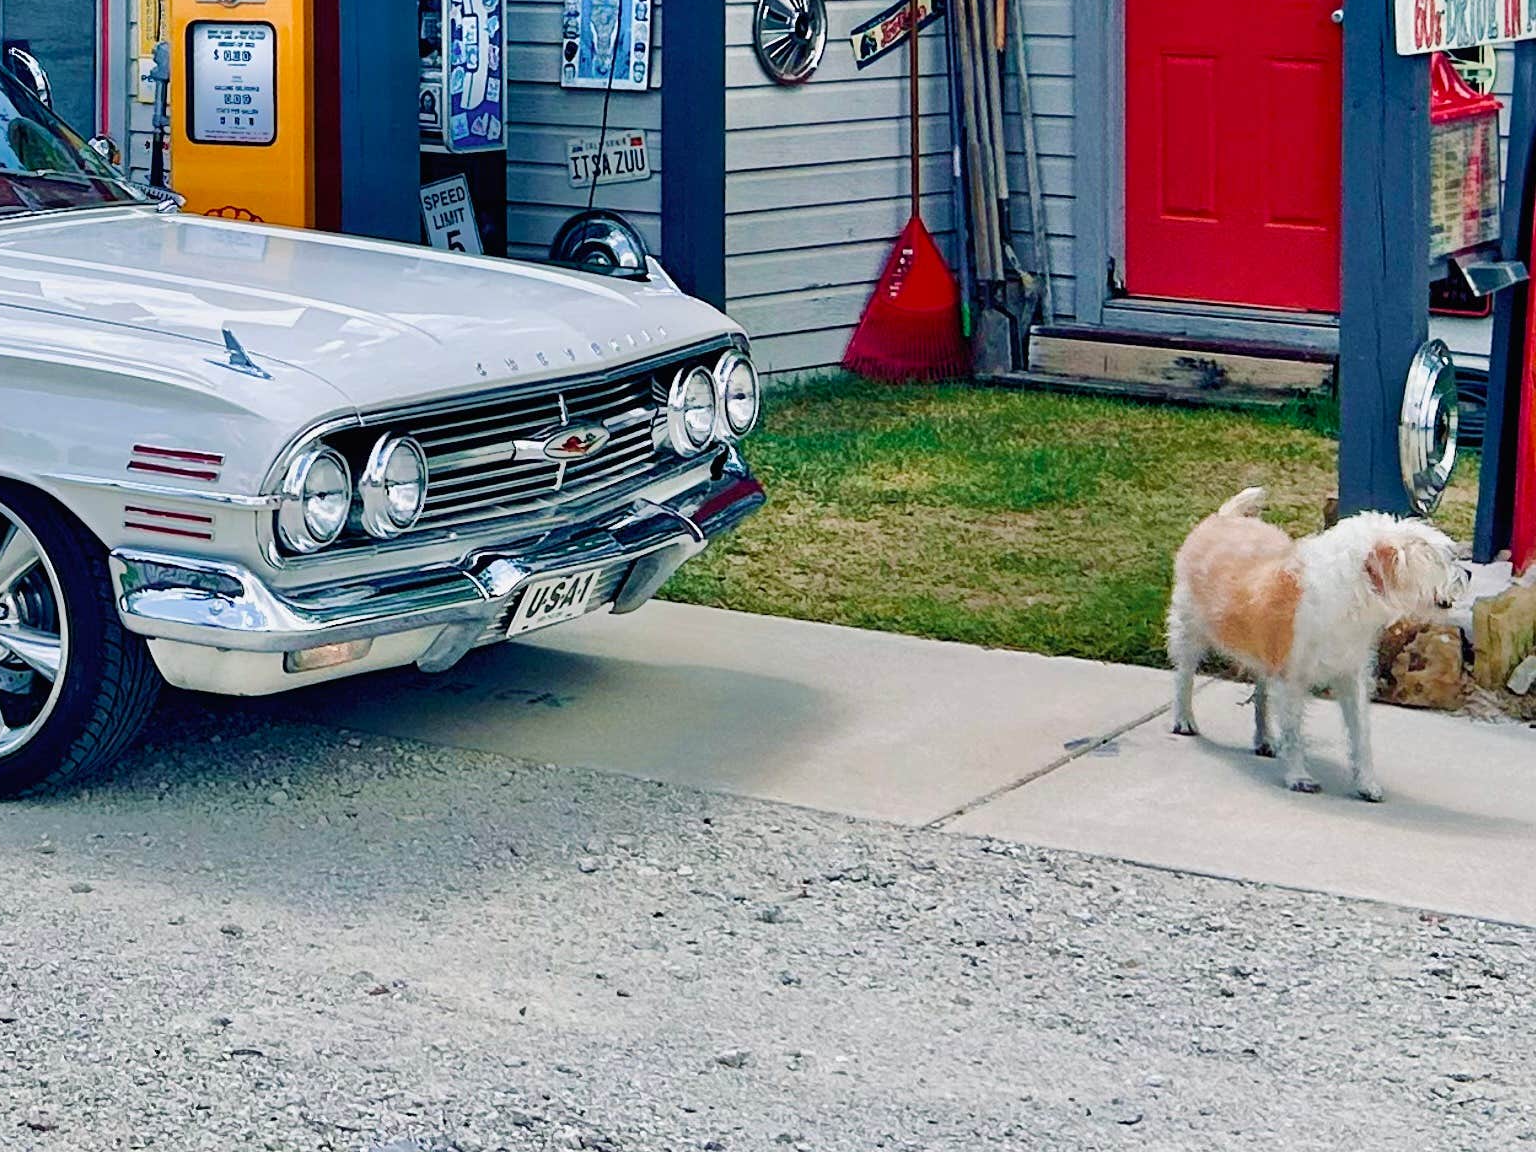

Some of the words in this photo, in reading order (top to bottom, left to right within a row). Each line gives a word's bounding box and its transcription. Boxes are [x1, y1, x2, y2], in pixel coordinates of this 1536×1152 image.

[570, 154, 611, 180] ITSA
[614, 149, 645, 175] ZUU
[423, 186, 465, 211] SPEED
[432, 207, 465, 230] LIMIT
[447, 230, 465, 254] 5
